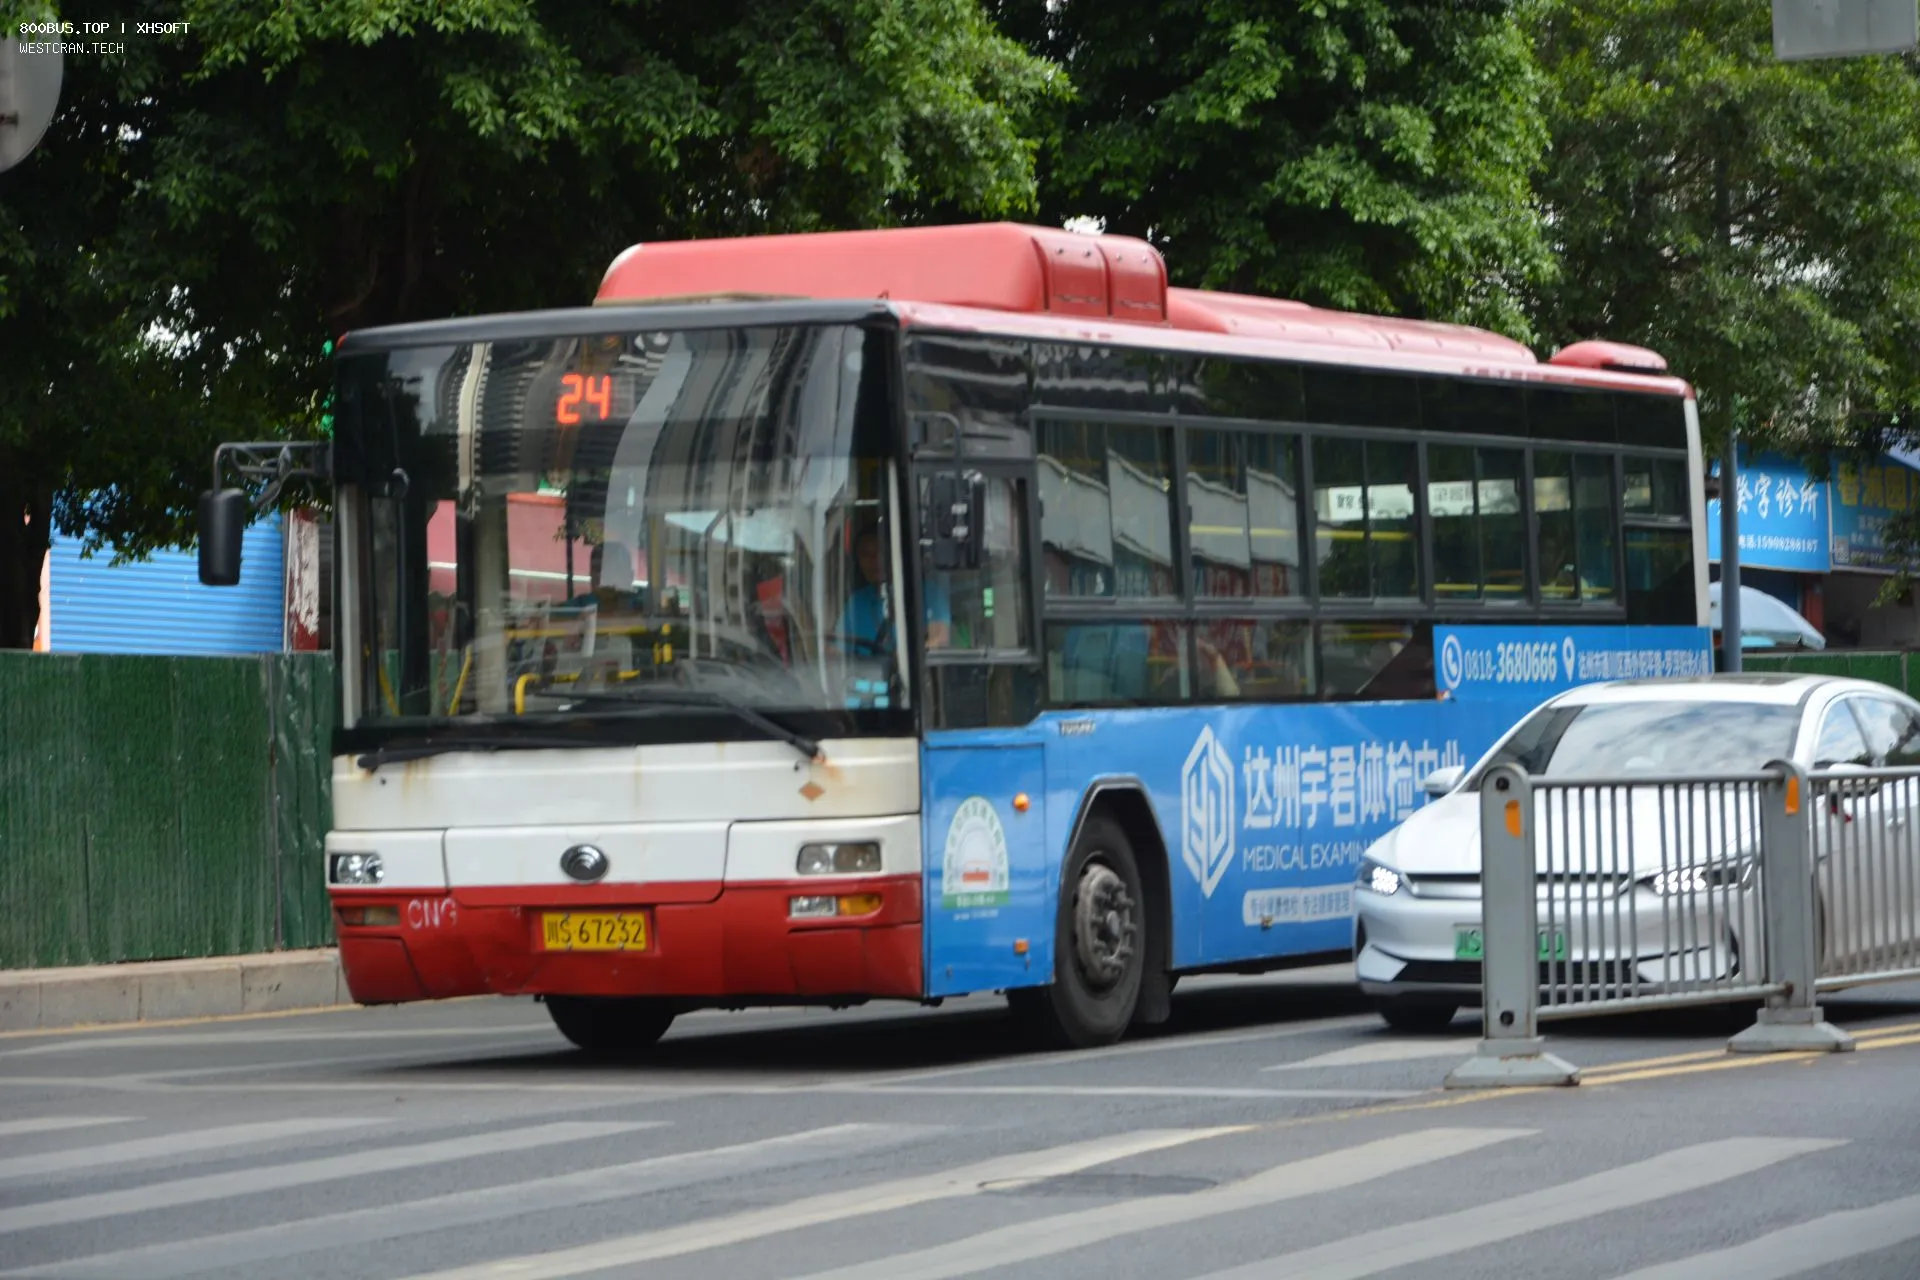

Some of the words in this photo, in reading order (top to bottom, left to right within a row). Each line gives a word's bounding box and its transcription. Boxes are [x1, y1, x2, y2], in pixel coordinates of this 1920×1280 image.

[556, 373, 612, 424] 24
[1243, 845, 1308, 872] MEDICAL
[1311, 839, 1374, 867] EXAMIN
